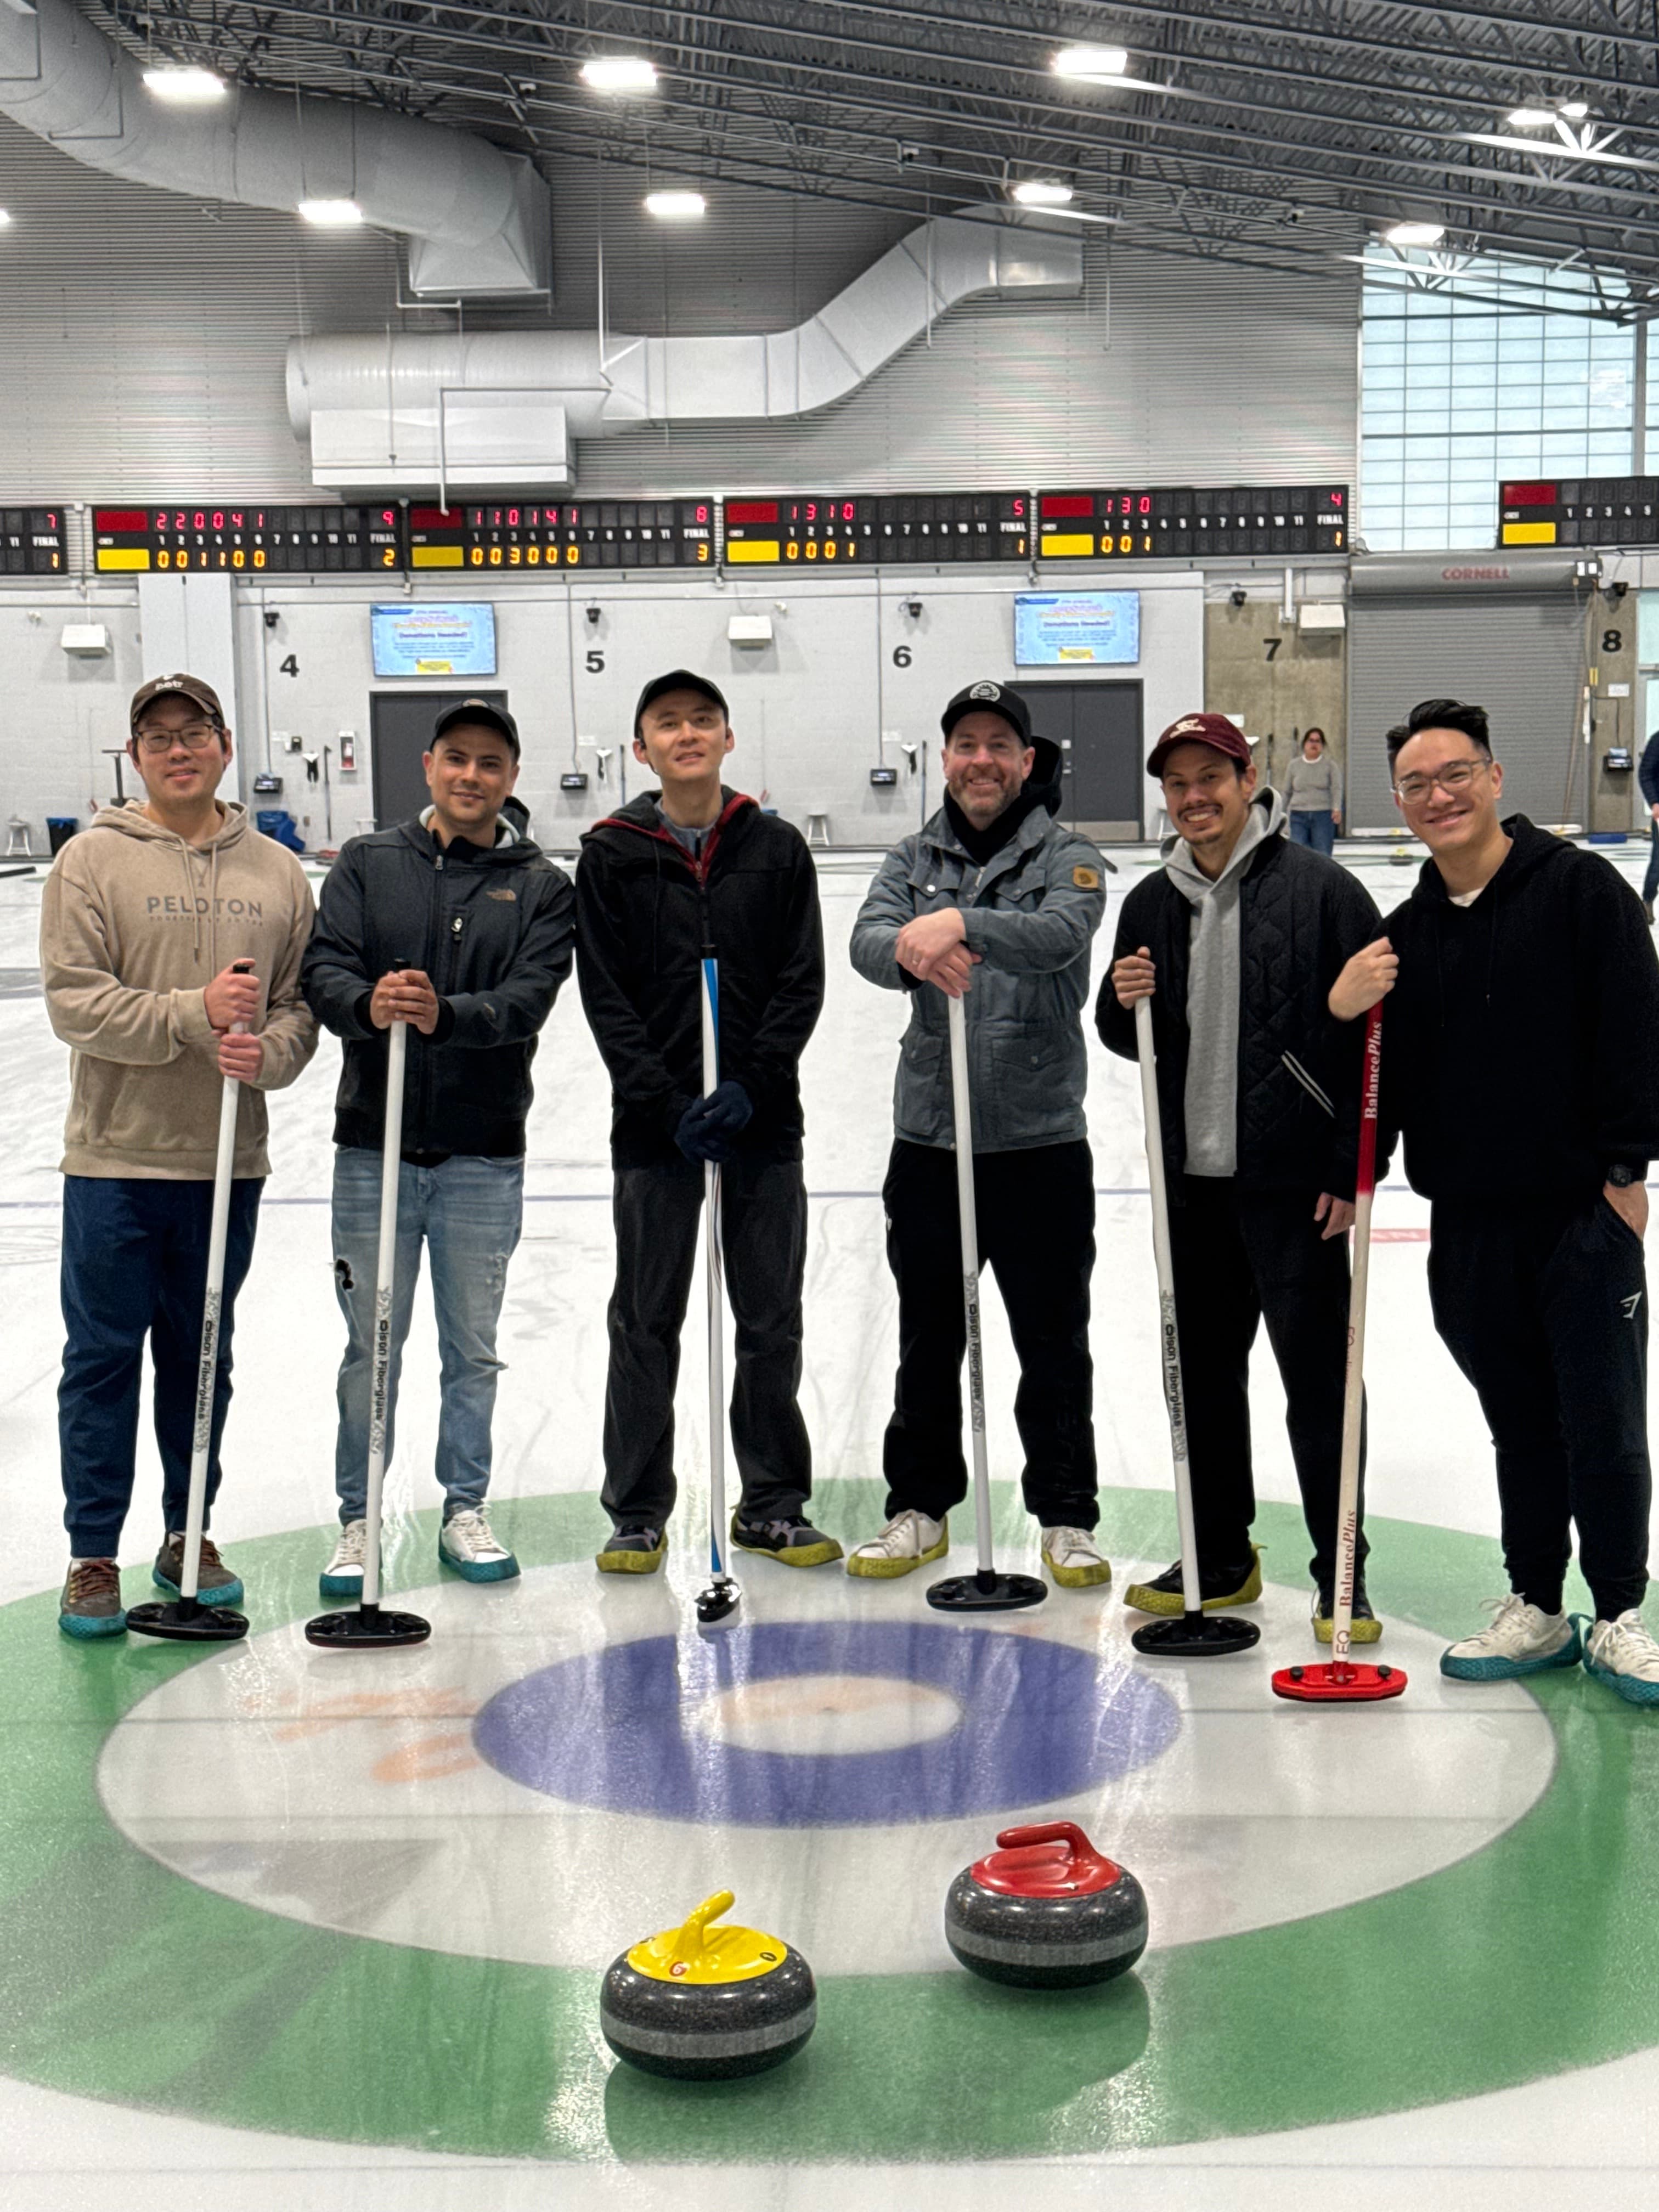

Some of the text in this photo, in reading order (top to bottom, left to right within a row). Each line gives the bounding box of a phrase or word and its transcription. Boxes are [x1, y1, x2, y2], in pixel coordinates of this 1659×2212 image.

[806, 504, 817, 520] 3
[842, 503, 854, 520] 0
[1013, 499, 1023, 516] 5
[1122, 497, 1131, 514] 3
[1139, 496, 1150, 513] 0
[1331, 493, 1342, 506] 4
[1567, 507, 1573, 518] 1
[1585, 507, 1593, 517] 2
[1605, 506, 1612, 517] 3
[47, 514, 57, 529] 7
[156, 512, 167, 530] 2
[176, 512, 185, 529] 2
[194, 512, 205, 529] 0
[213, 511, 224, 529] 0
[232, 513, 243, 527] 4
[383, 511, 393, 526] 9
[509, 509, 518, 526] 0
[546, 510, 557, 524] 4
[1104, 520, 1110, 530] 1
[1122, 519, 1130, 530] 2
[1142, 519, 1149, 529] 3
[1294, 515, 1304, 526] 11
[1317, 514, 1344, 525] FINAL
[159, 535, 165, 545] 1
[178, 534, 185, 545] 2
[196, 534, 204, 545] 3
[347, 534, 357, 543] 11
[370, 533, 396, 543] FINAL
[473, 532, 479, 542] 1
[492, 532, 499, 542] 2
[511, 532, 517, 541] 3
[660, 529, 670, 539] 11
[683, 528, 710, 539] FINAL
[789, 526, 795, 537] 1
[808, 526, 815, 537] 2
[826, 526, 833, 536] 3
[977, 523, 987, 533] 11
[1000, 522, 1026, 533] FINAL
[9, 536, 59, 547] 11 FINAL
[787, 543, 798, 560] 0
[805, 541, 817, 559] 0
[825, 541, 836, 559] 0
[1101, 535, 1113, 553] 0
[1120, 535, 1132, 552] 0
[157, 550, 169, 568] 0
[176, 550, 188, 568] 0
[233, 550, 244, 567] 0
[253, 550, 265, 567] 0
[383, 549, 394, 566] 2
[471, 543, 708, 565] 0 0 3 0 0 0 3
[1441, 567, 1510, 580] CORNELL
[1263, 639, 1282, 661] 7
[1602, 629, 1622, 652] 8
[280, 654, 300, 677] 4
[586, 651, 605, 673] 5
[893, 645, 911, 668] 6
[146, 896, 263, 918] PELOTON
[1339, 1510, 1356, 1606] BalancePlus
